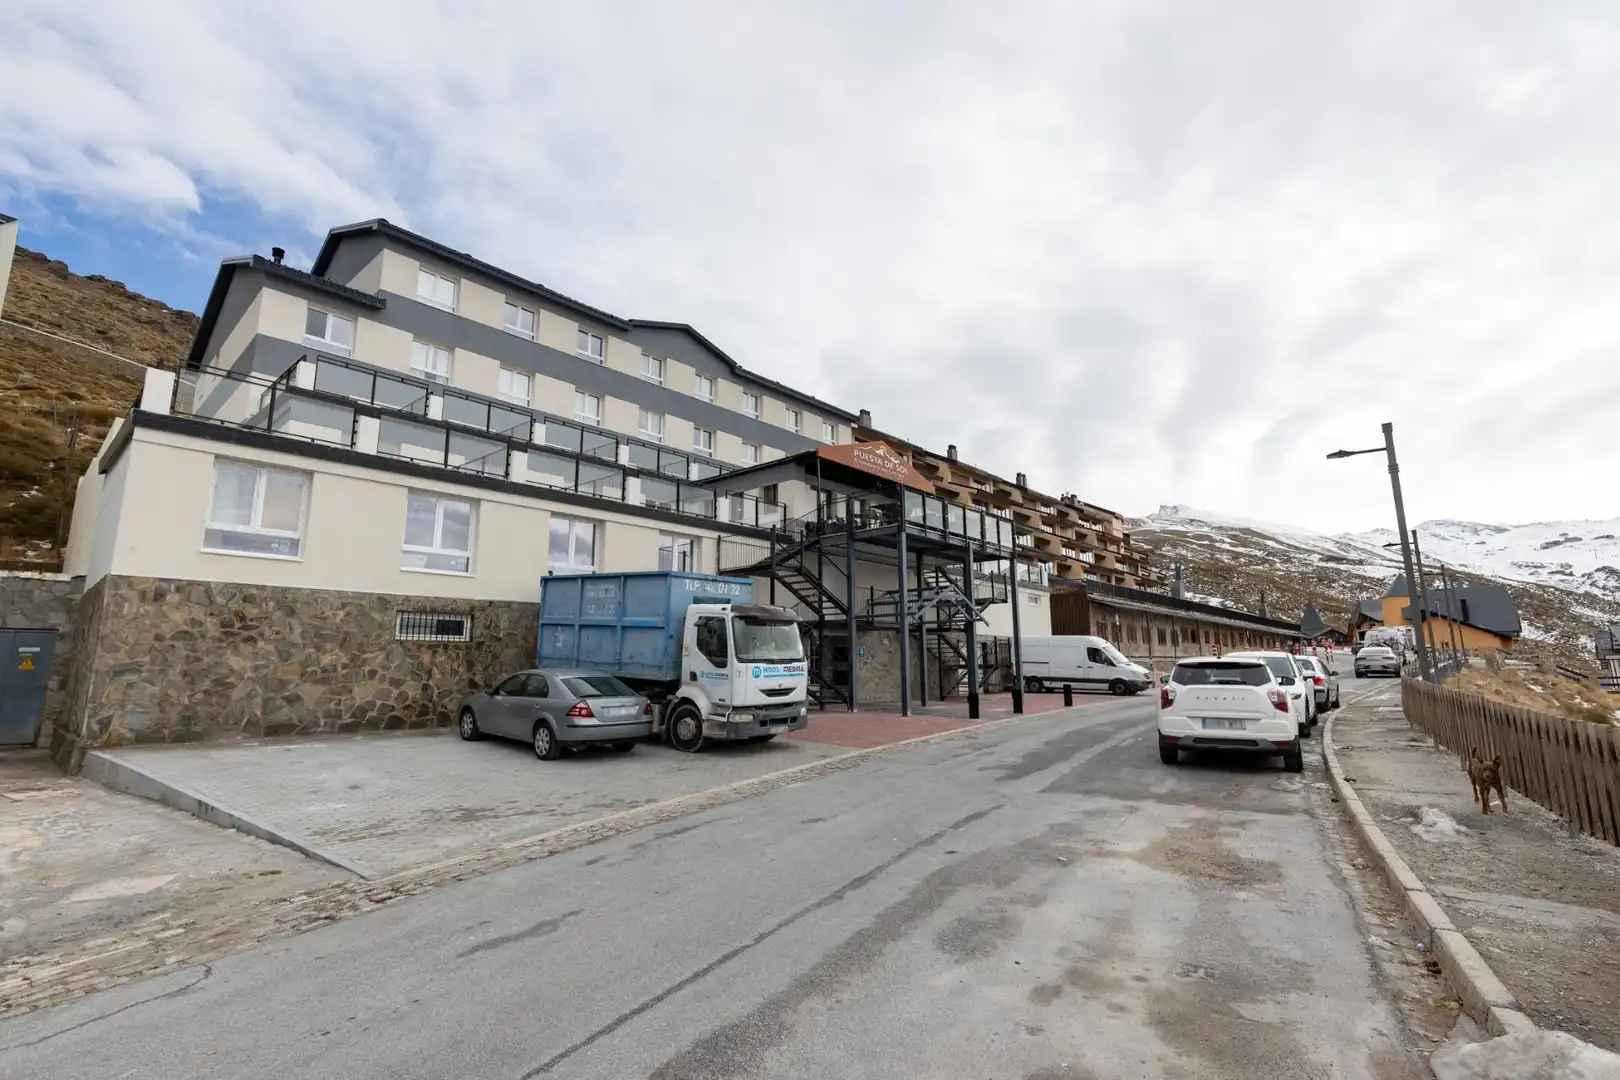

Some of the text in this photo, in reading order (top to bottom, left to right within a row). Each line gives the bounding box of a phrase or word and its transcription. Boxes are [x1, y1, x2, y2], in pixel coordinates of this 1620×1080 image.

[854, 449, 883, 466] PUESTA
[884, 460, 895, 470] DE
[895, 463, 909, 476] SOL
